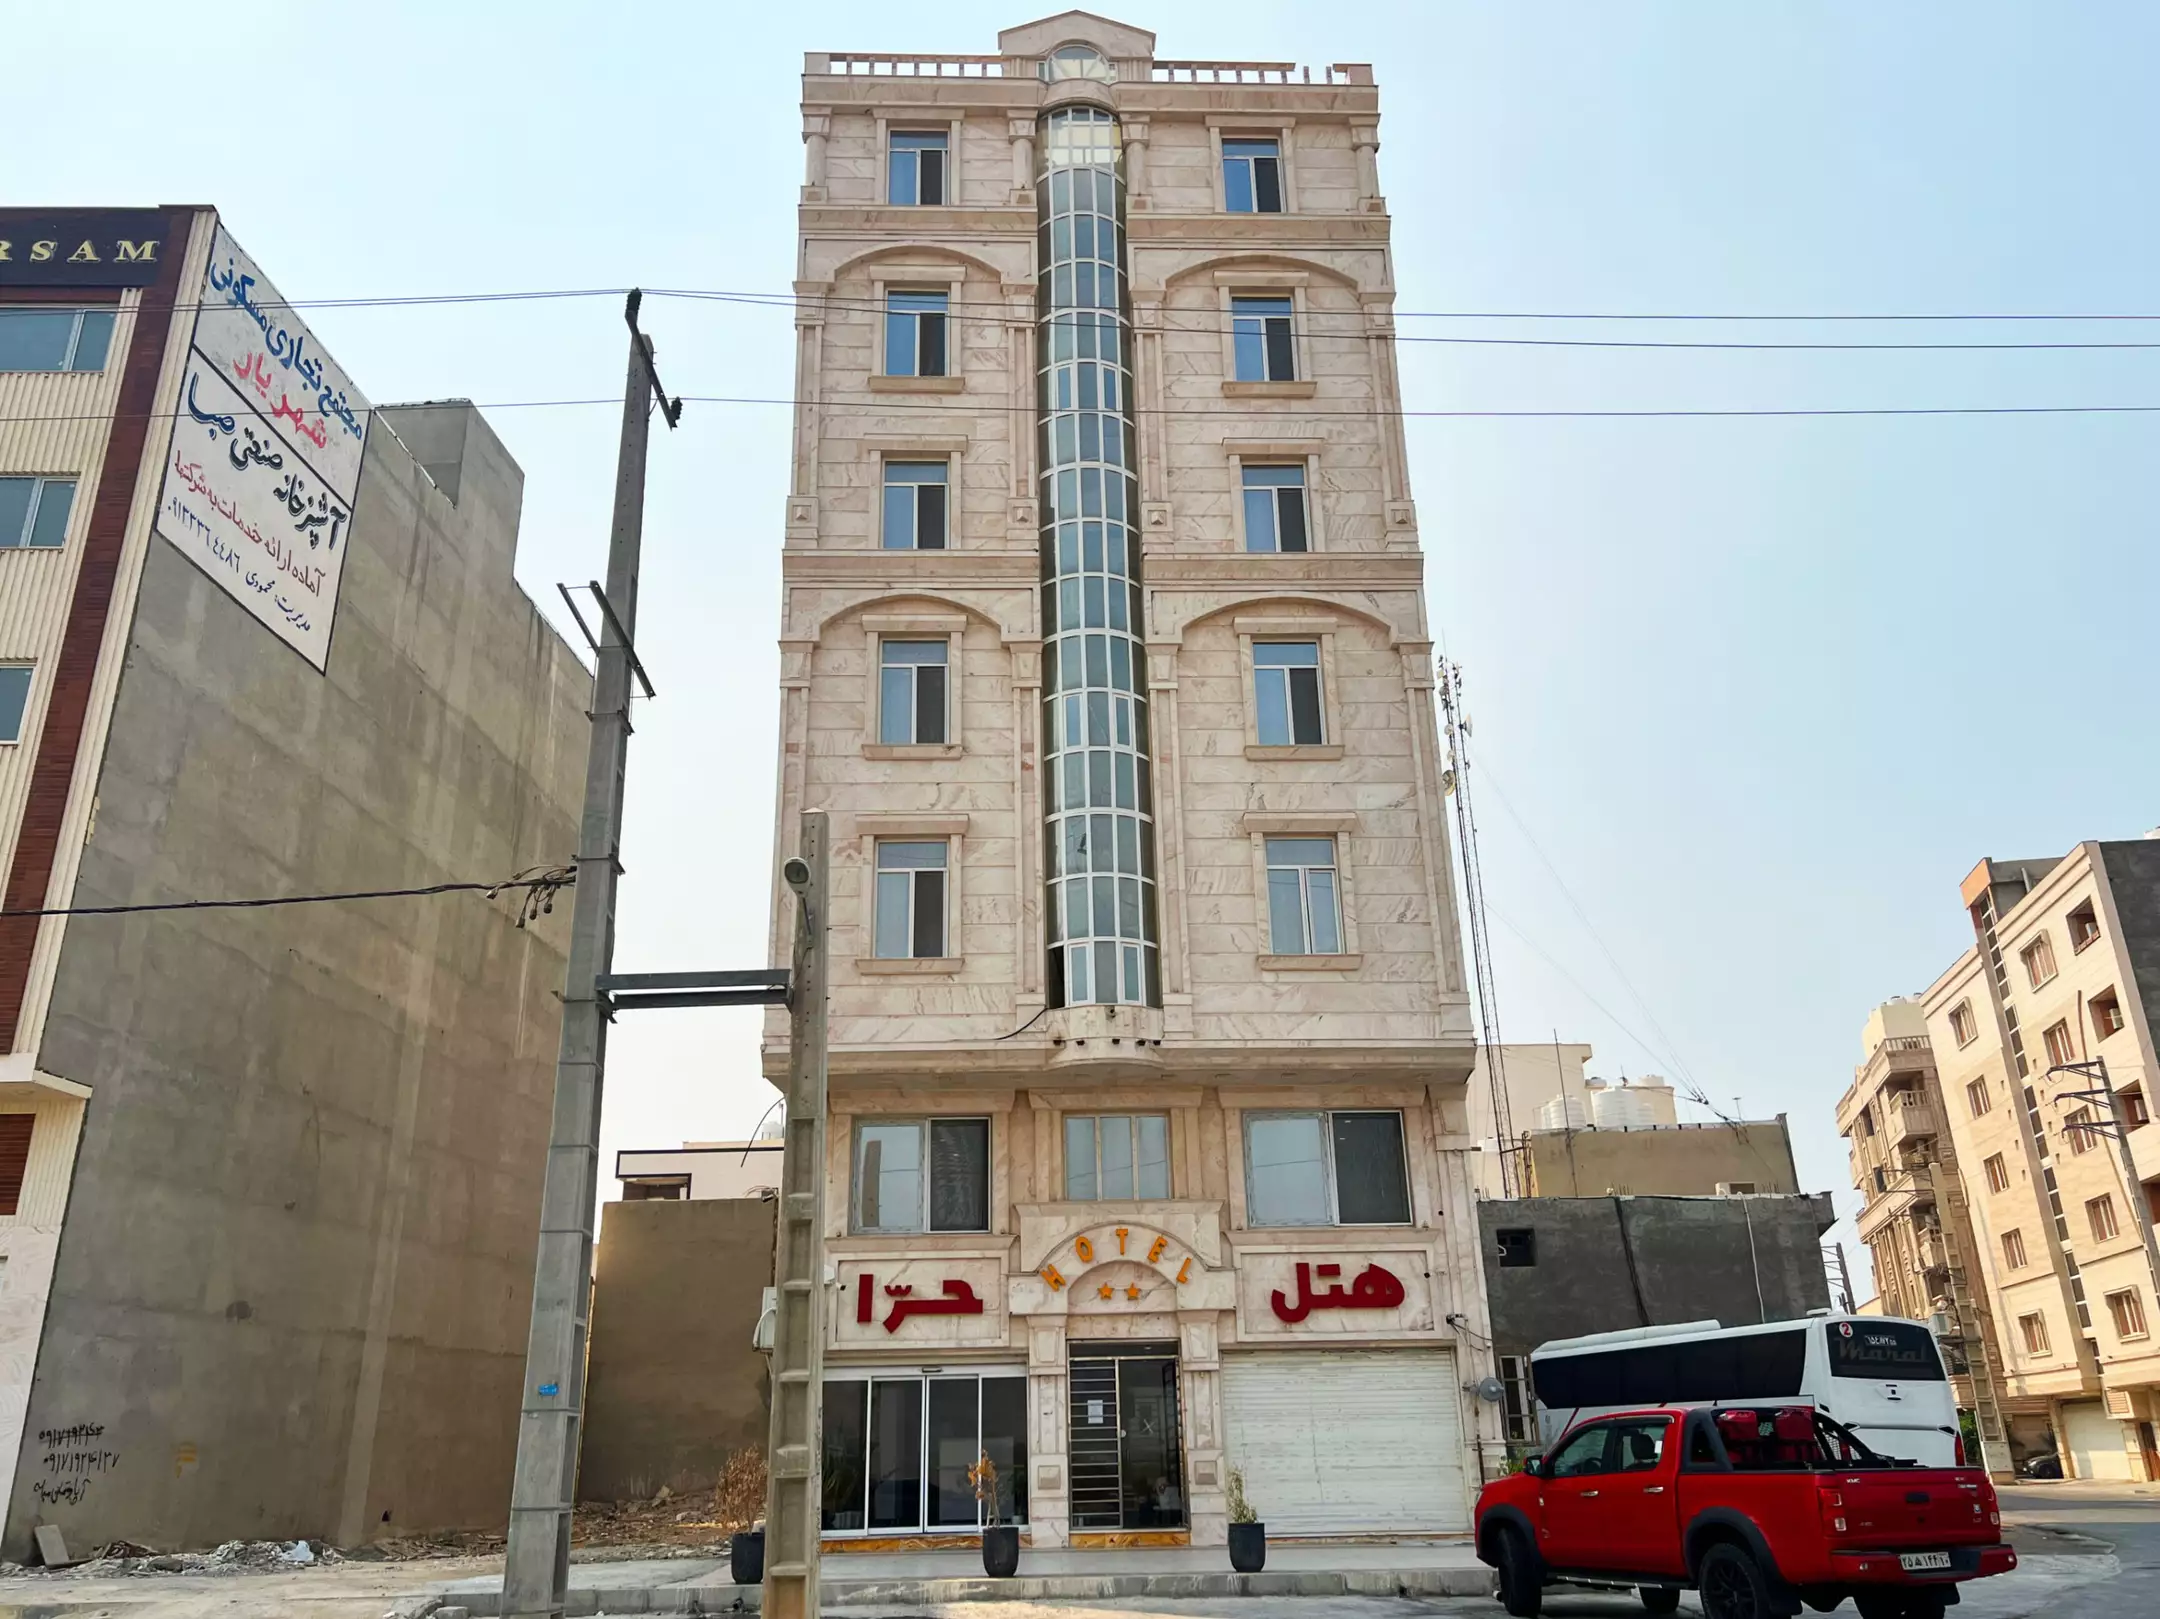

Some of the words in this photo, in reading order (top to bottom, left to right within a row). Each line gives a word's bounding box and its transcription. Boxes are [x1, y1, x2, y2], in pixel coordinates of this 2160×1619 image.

[210, 257, 267, 332] مسکونی
[265, 326, 323, 391] تجاری
[187, 371, 236, 441] صبا
[318, 385, 362, 440] مجتمع
[229, 427, 284, 471] صنعتی
[218, 501, 263, 544] خدمات
[273, 473, 347, 550] آشپزخانه
[292, 565, 326, 597] آماده
[1039, 1228, 1193, 1292] HOTEL
[1271, 1262, 1405, 1323] هتل
[1841, 1323, 1851, 1336] 2
